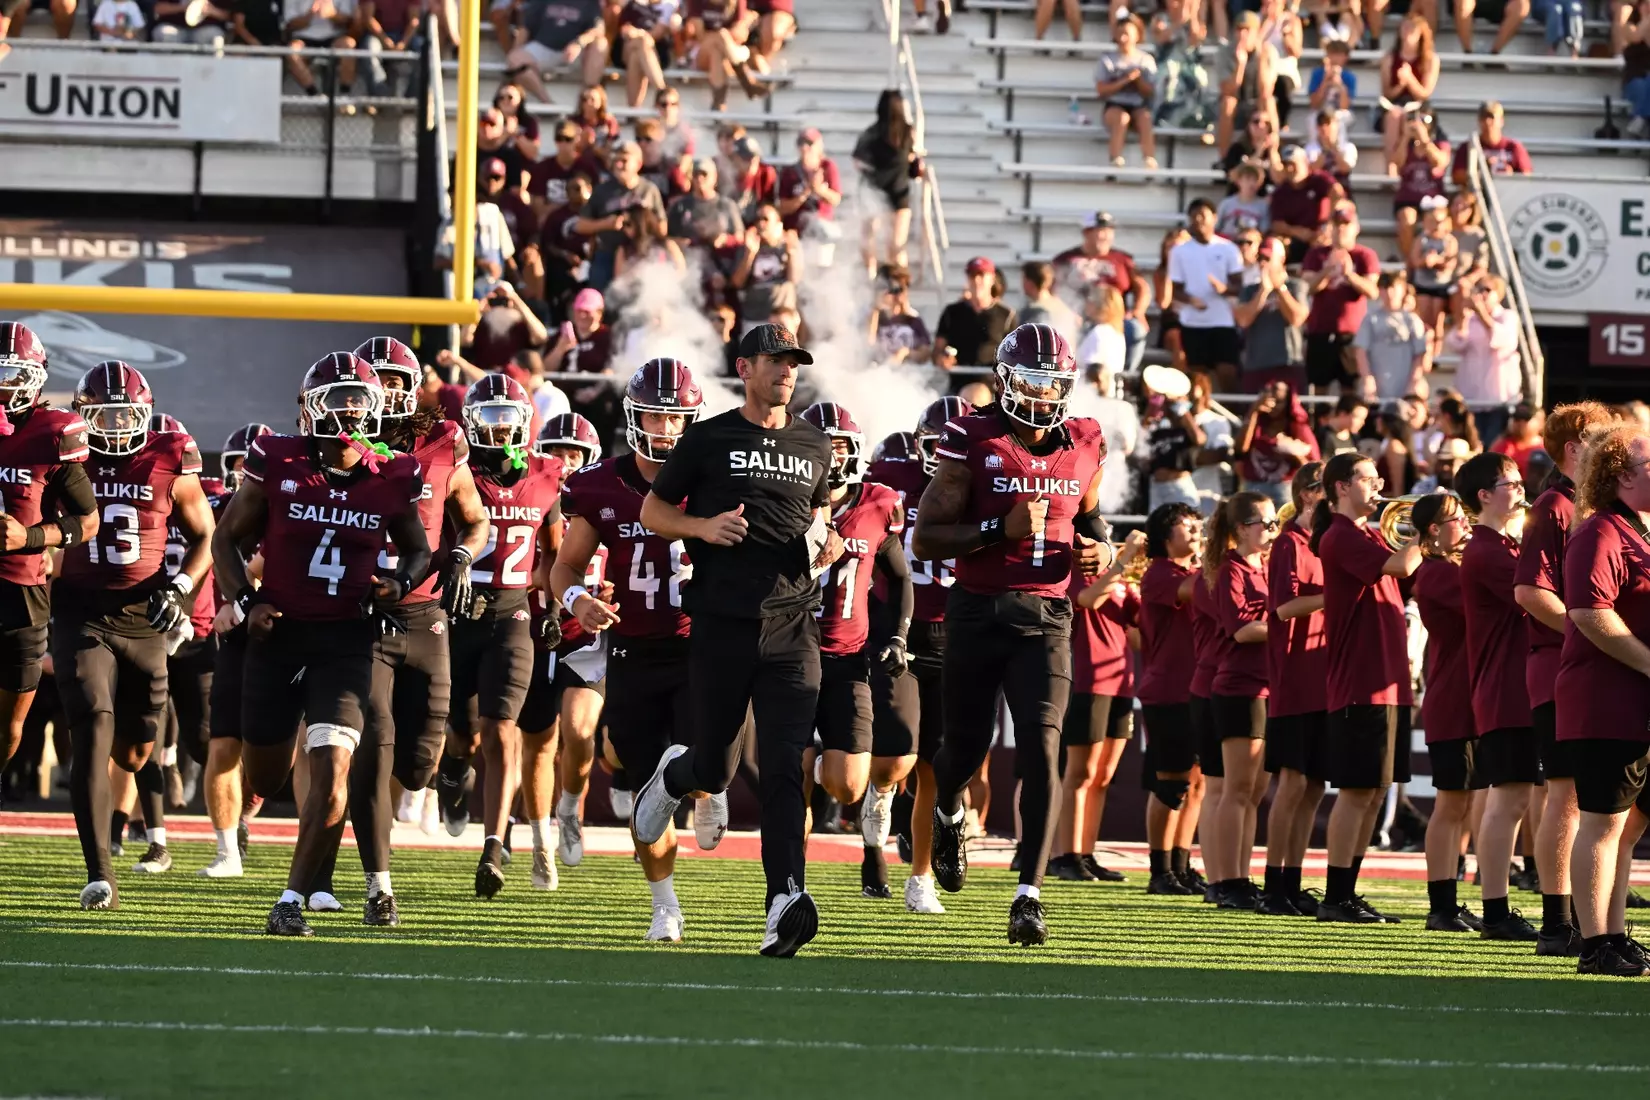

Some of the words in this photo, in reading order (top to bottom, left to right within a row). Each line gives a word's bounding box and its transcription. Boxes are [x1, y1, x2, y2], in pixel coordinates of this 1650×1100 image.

[26, 73, 181, 119] UNION
[0, 236, 188, 260] LLINOIS
[1601, 323, 1646, 356] 15
[1040, 362, 1055, 370] SIU
[729, 450, 813, 480] SALUKI
[749, 471, 798, 484] FOOTBALL
[992, 476, 1081, 496] SALUKIS
[288, 502, 382, 529] SALUKIS
[308, 528, 347, 596] 4
[470, 525, 535, 585] 22
